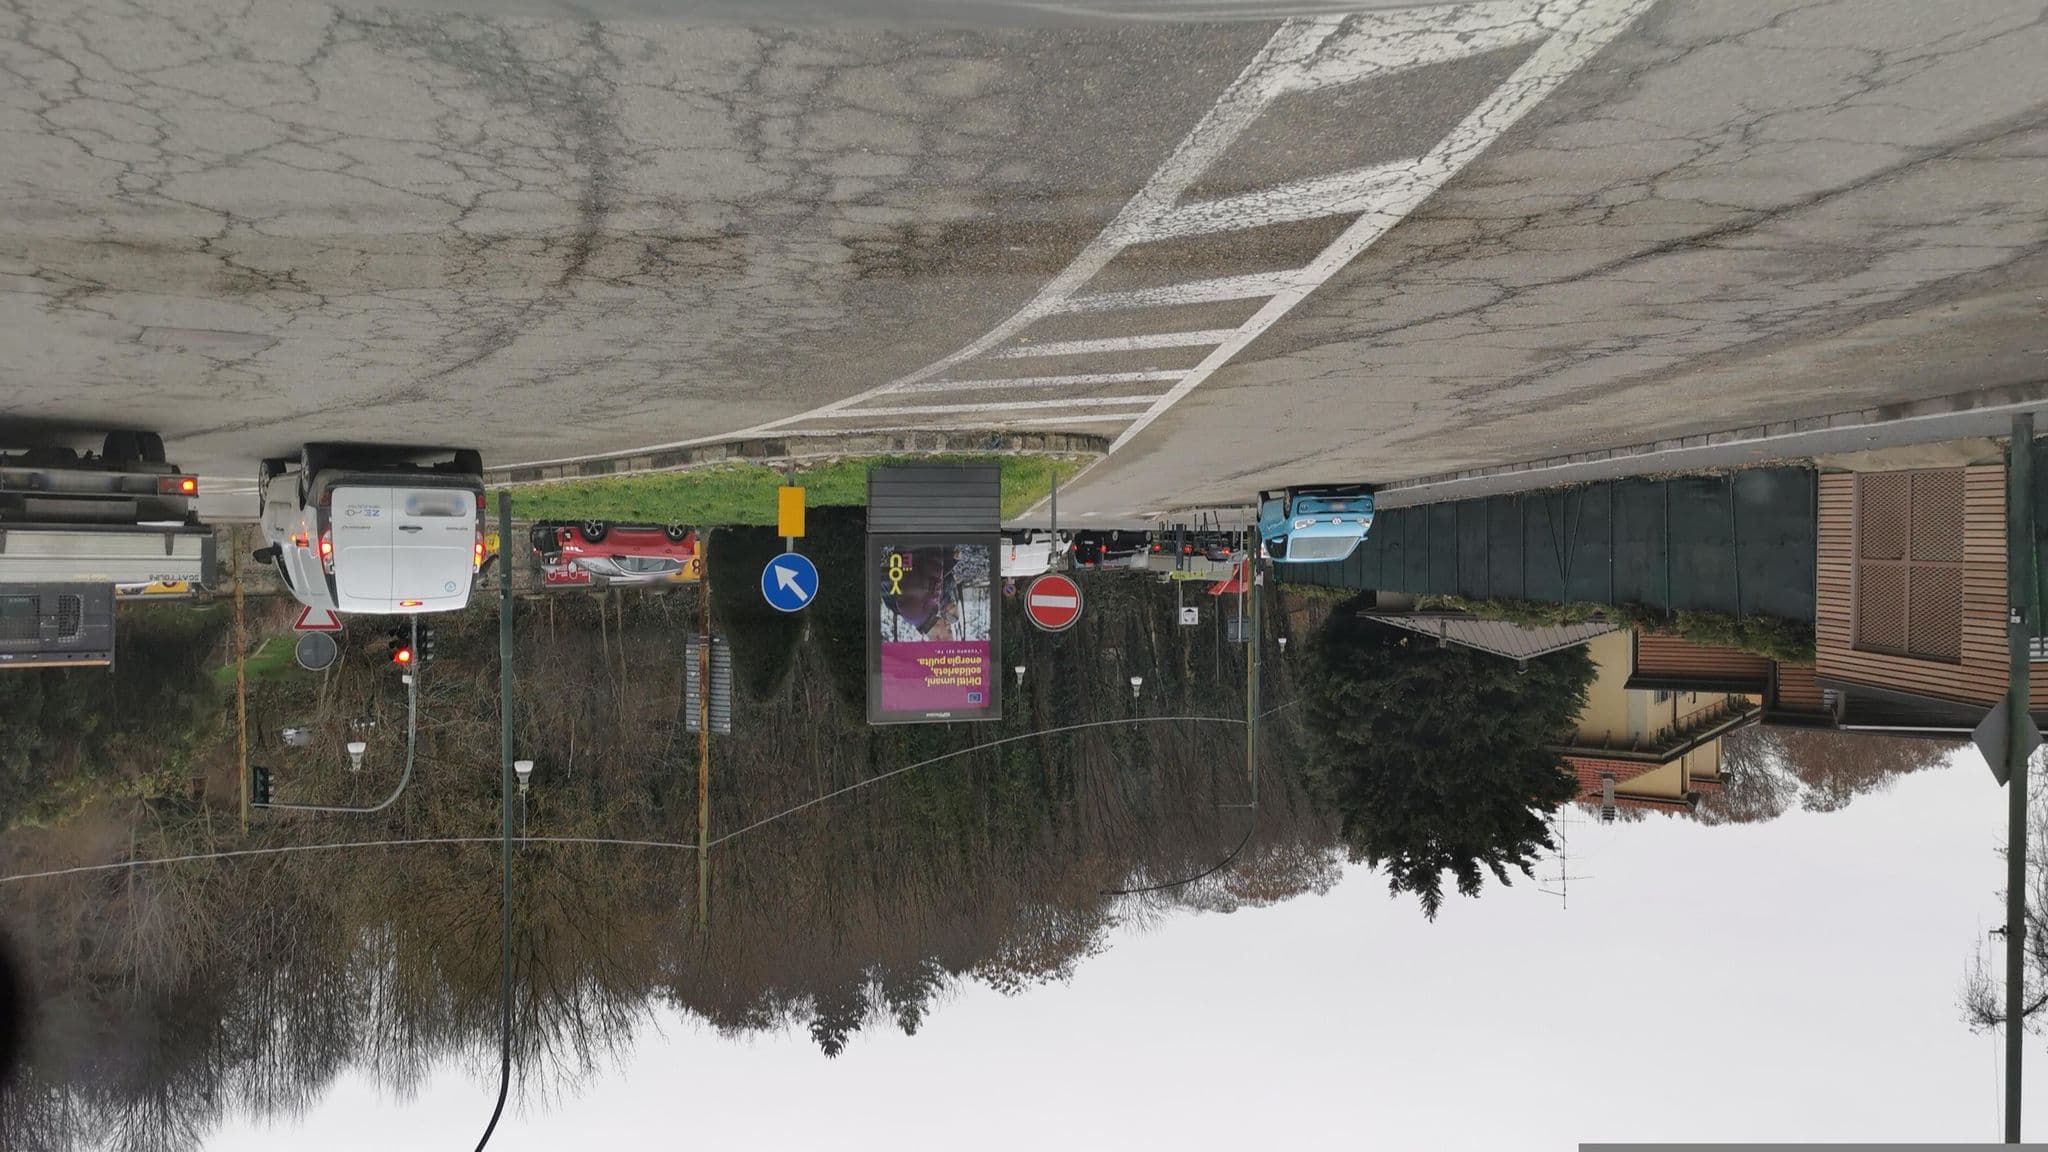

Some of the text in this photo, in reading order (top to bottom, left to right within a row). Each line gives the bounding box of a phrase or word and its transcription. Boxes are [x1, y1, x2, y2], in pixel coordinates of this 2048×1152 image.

[917, 656, 982, 668] energia pulita.
[930, 667, 982, 677] solidarietà,
[924, 676, 982, 687] Diritti umani,
